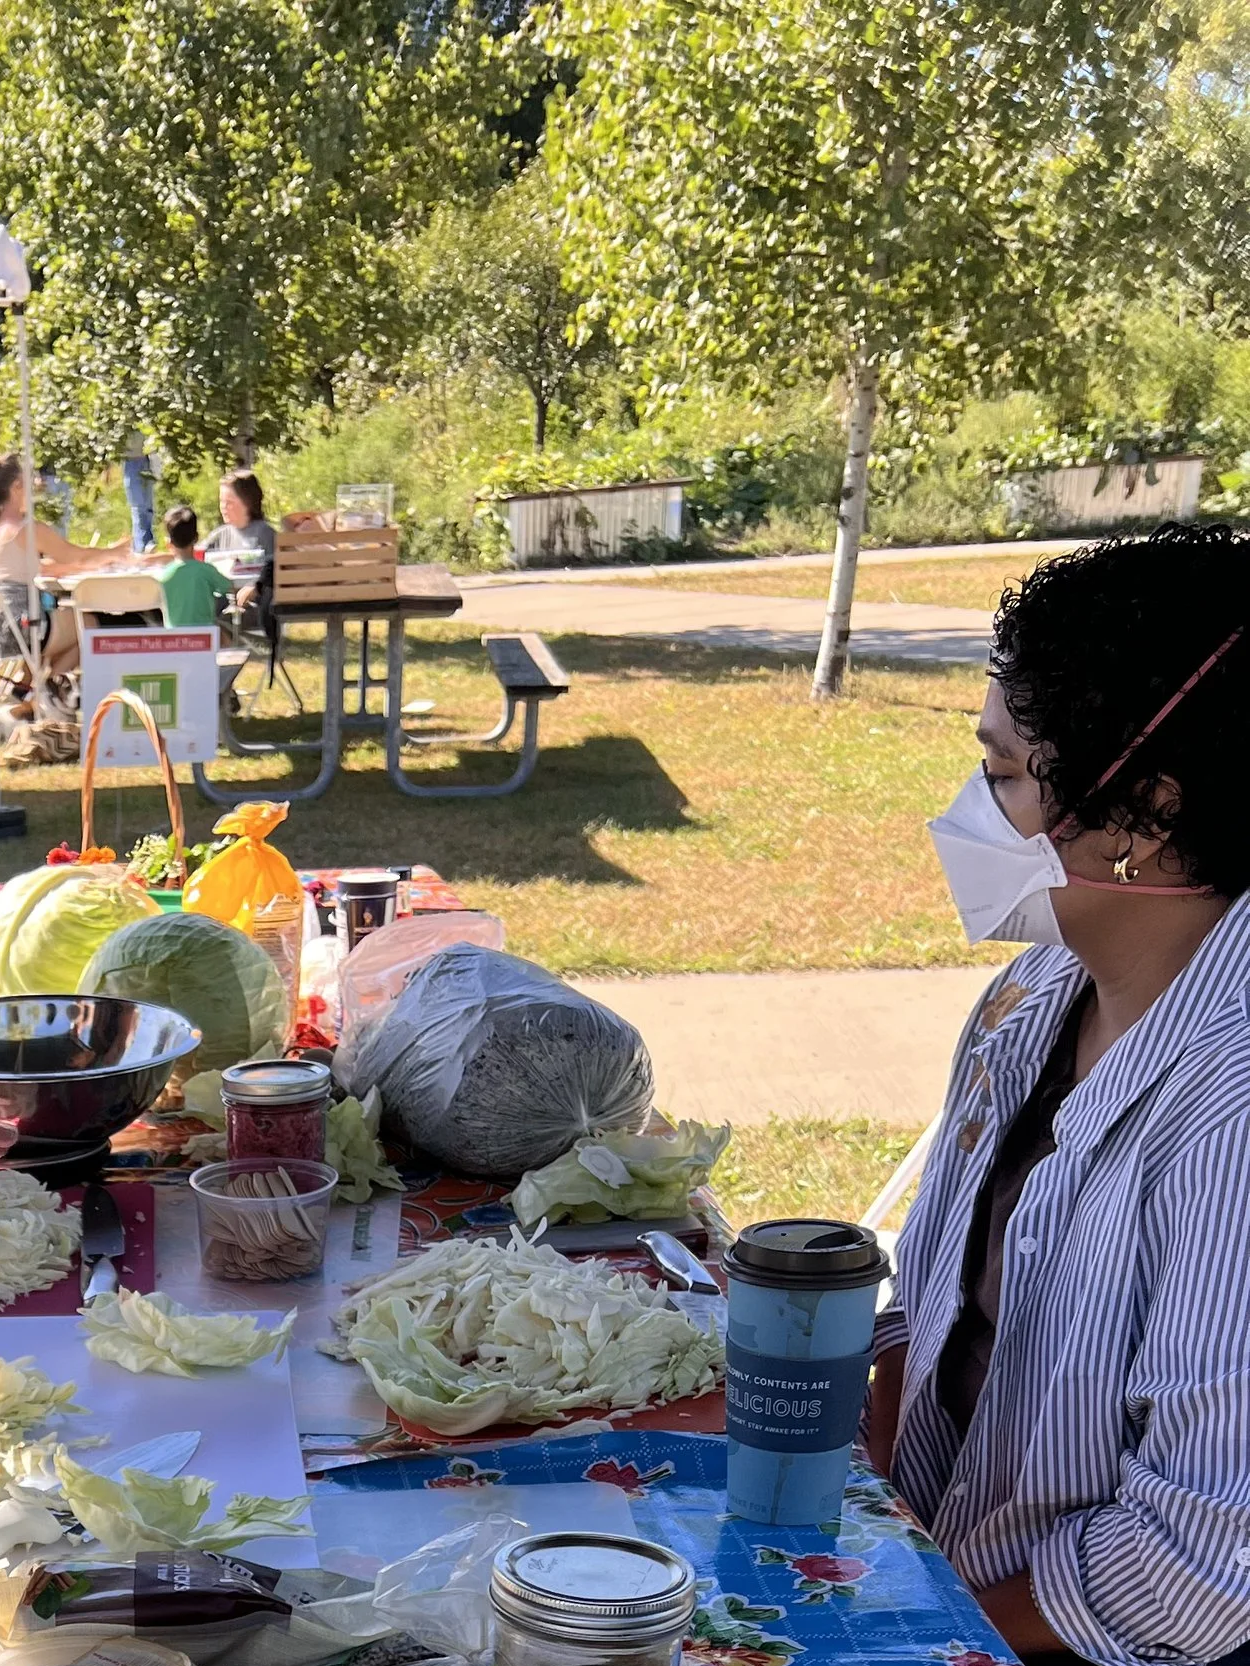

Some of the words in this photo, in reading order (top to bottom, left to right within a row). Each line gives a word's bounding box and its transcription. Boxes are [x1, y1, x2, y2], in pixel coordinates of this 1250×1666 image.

[753, 1376, 808, 1391] CONTENTS
[810, 1380, 831, 1390] ARE
[727, 1383, 823, 1418] ELICIOUS
[764, 1426, 790, 1435] AWAKE
[790, 1428, 805, 1436] FOR
[173, 1563, 191, 1592] STICKS
